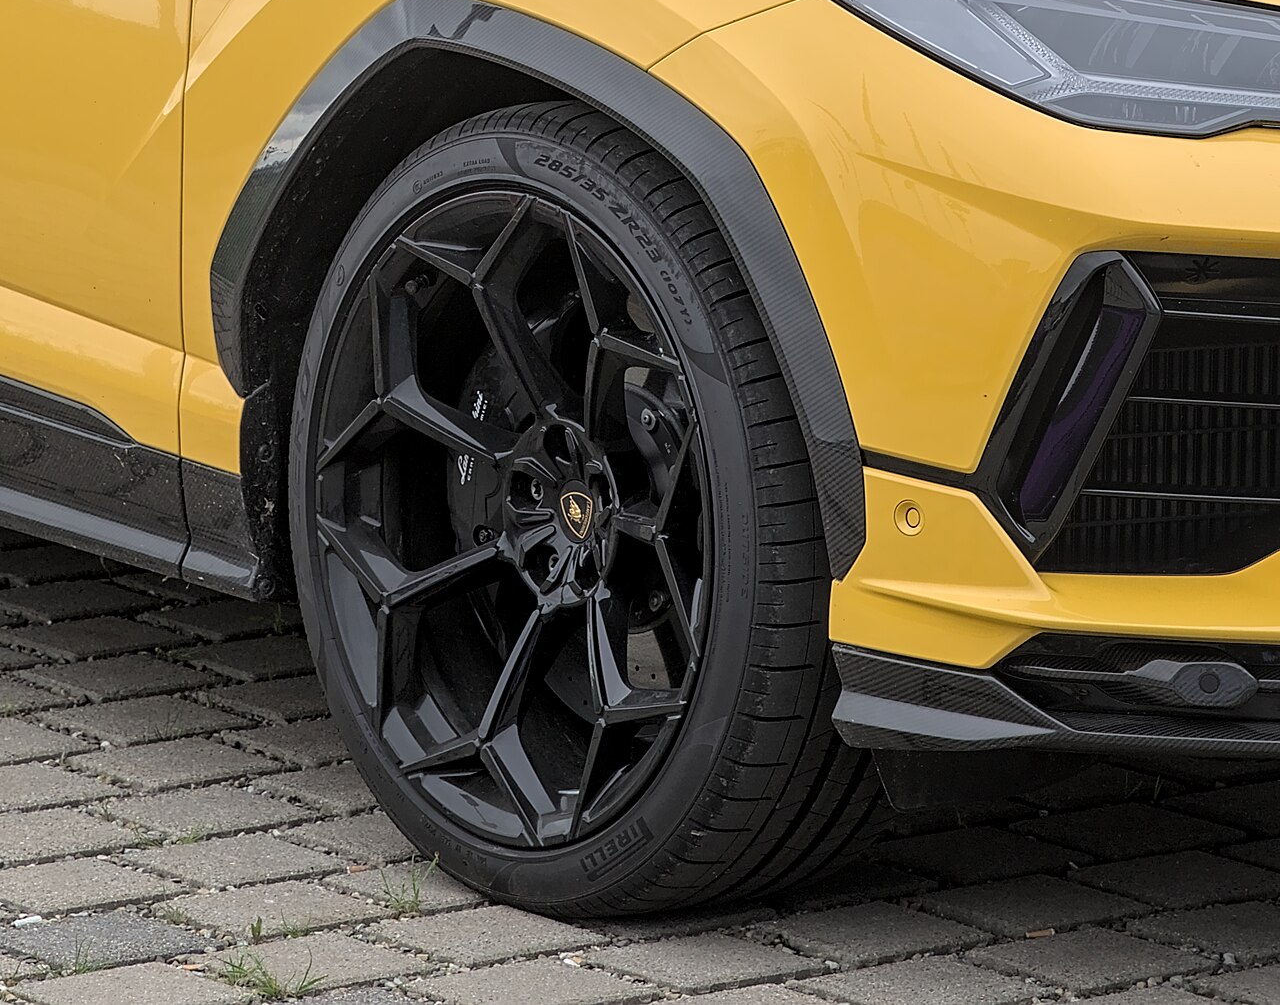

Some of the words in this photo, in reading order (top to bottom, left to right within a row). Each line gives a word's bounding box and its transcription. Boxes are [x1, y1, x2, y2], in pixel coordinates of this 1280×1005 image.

[534, 154, 609, 202] 285/35
[608, 204, 662, 264] ZR23
[580, 816, 655, 883] PIRELLI
